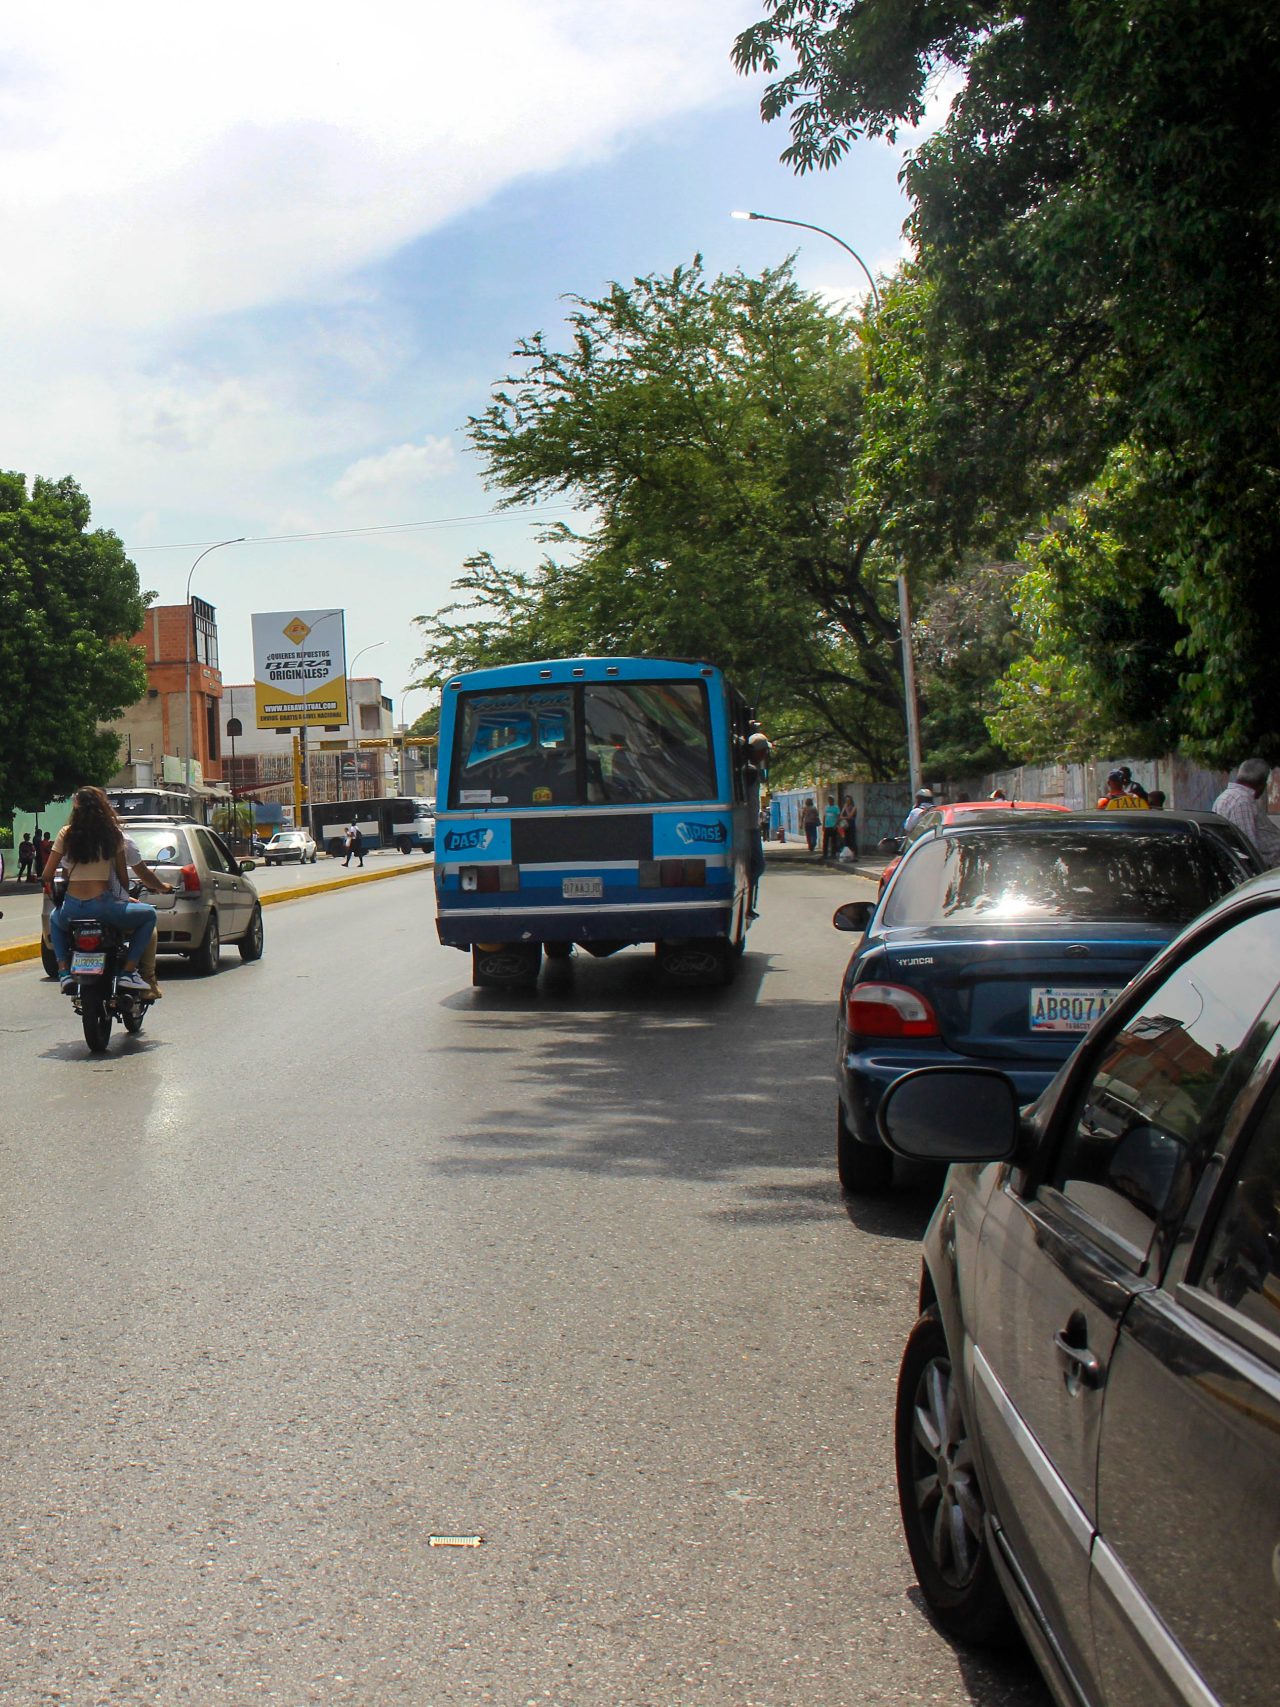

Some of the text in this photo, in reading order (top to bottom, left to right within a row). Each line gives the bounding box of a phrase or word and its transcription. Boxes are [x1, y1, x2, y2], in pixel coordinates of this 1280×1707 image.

[267, 652, 295, 660] ¿QUIERES
[265, 660, 331, 670] BERA
[270, 668, 329, 680] ORIGINALES?
[1114, 797, 1140, 809] TAXI
